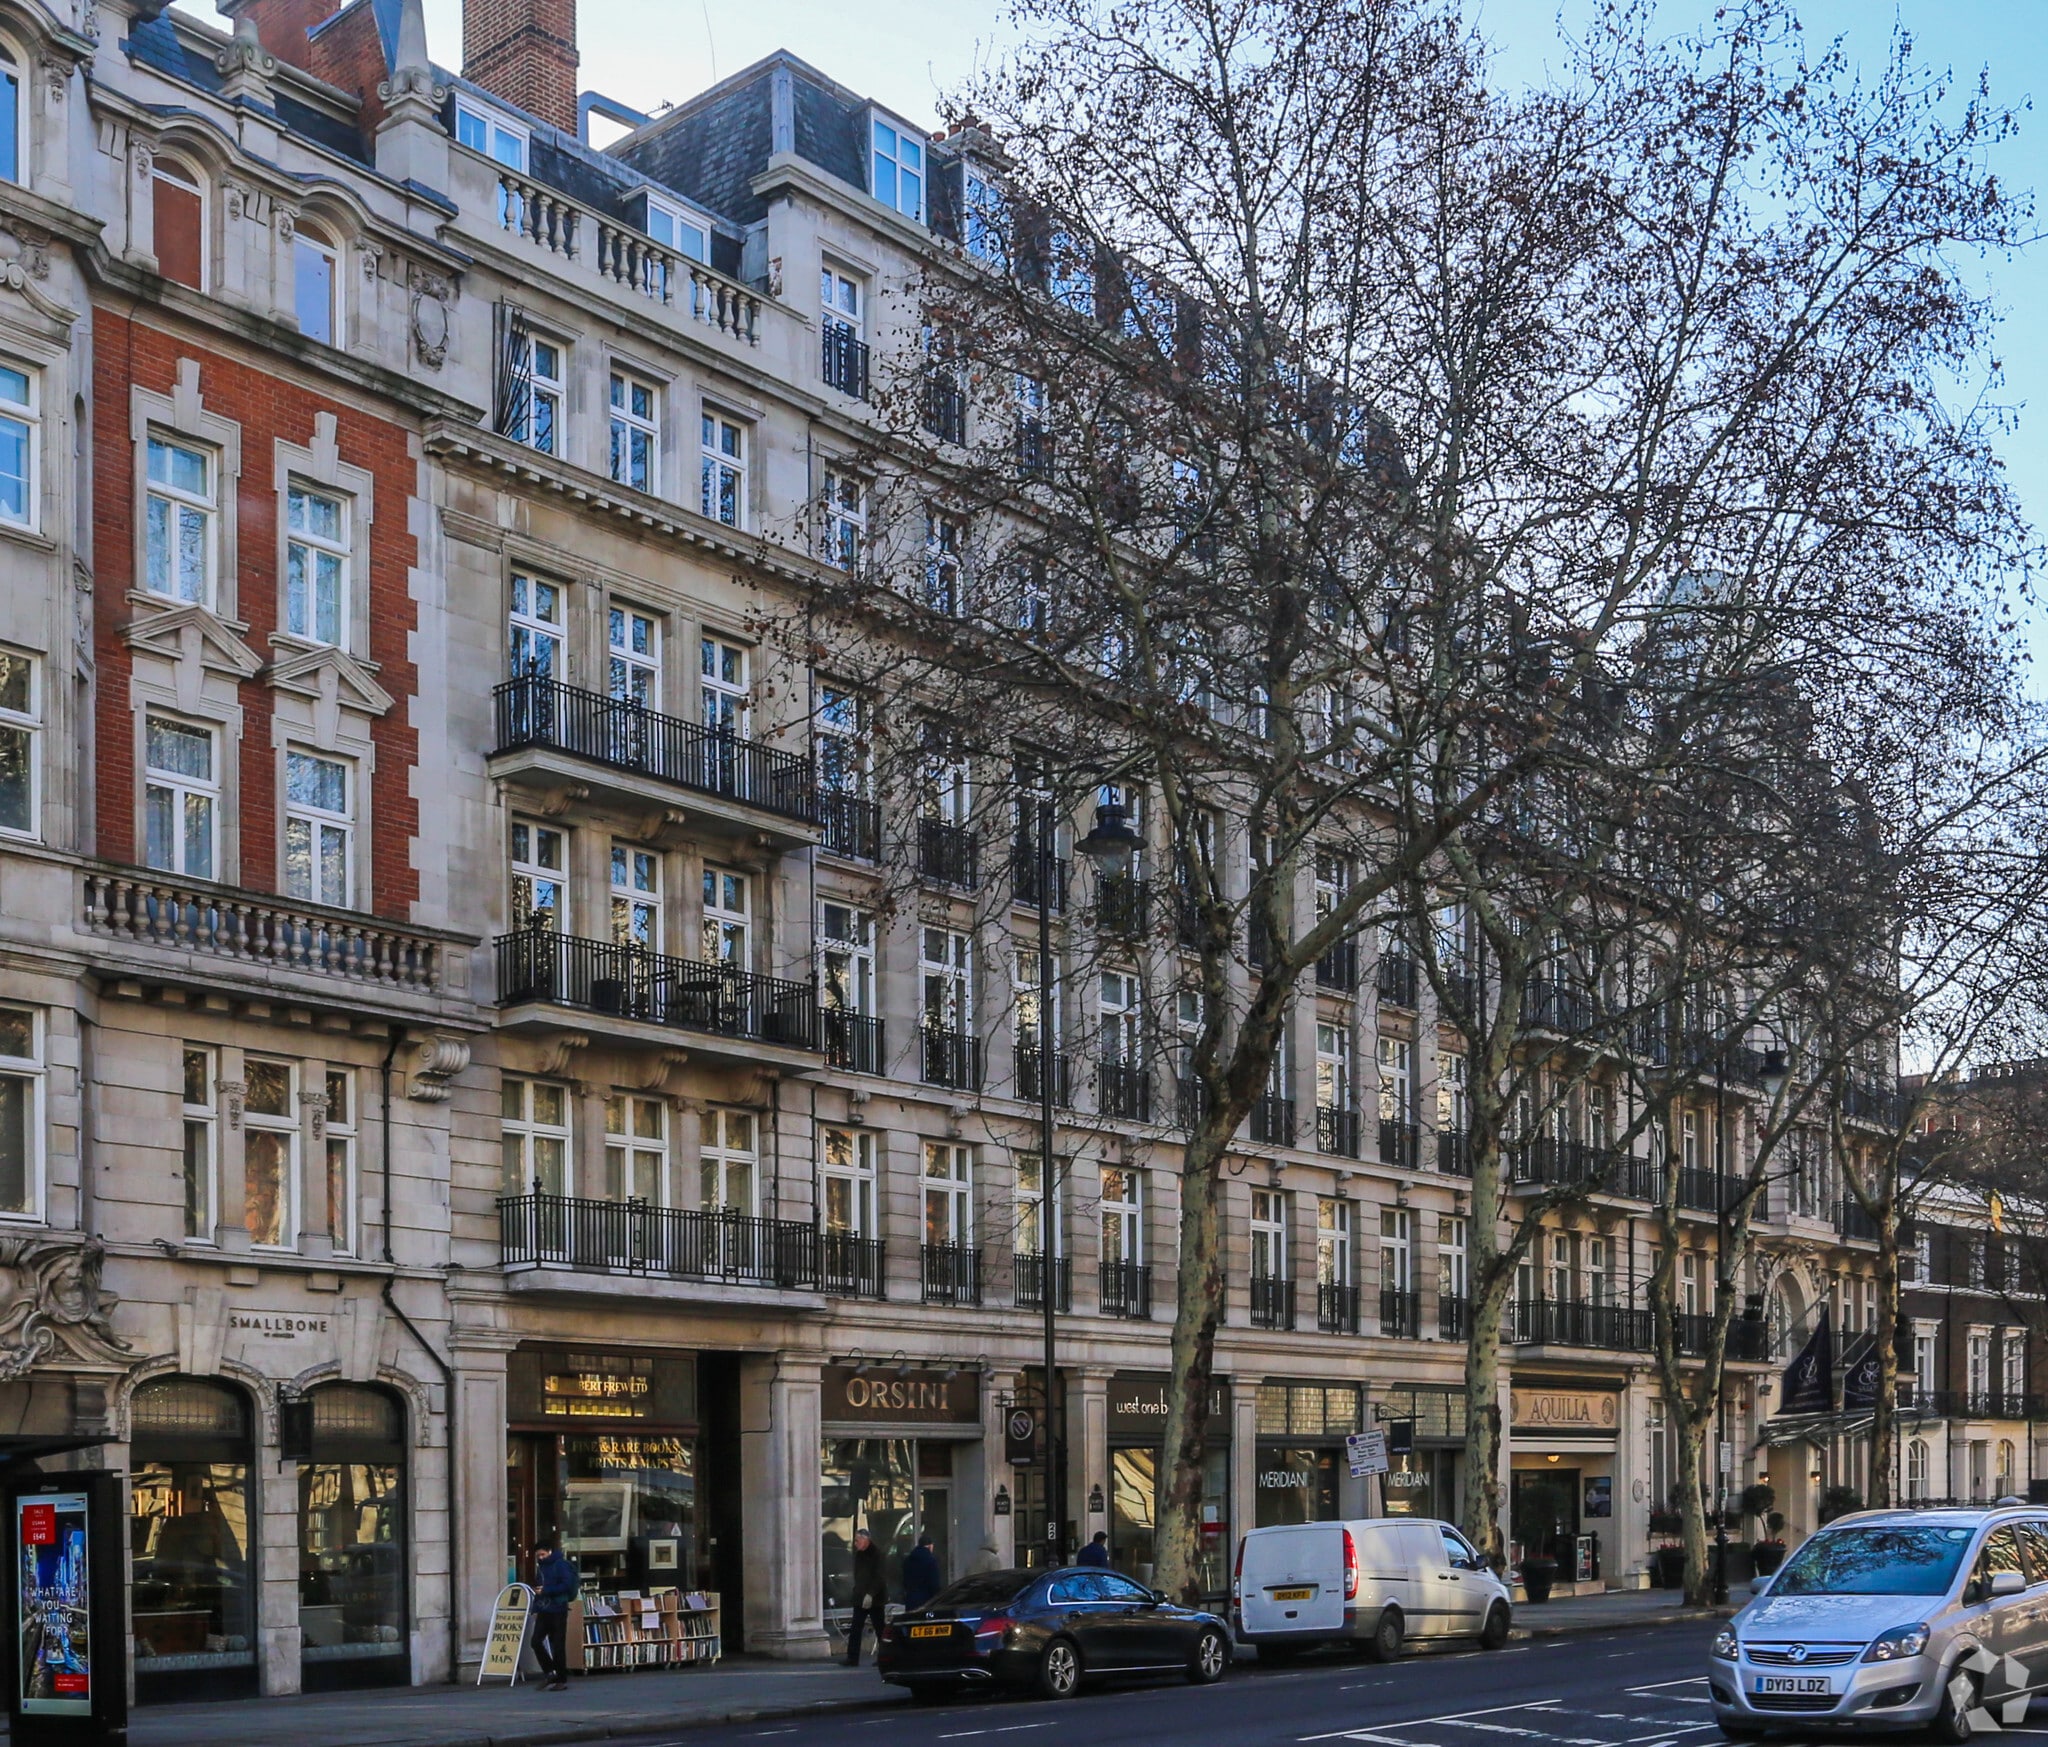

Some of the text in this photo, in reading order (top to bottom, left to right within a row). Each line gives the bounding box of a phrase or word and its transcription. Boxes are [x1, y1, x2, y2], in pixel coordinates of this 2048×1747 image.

[230, 1316, 327, 1332] SMALLBONE
[604, 1382, 629, 1393] FREW
[630, 1383, 648, 1393] LTD
[846, 1378, 949, 1409] ORSINI
[1116, 1396, 1159, 1414] west one
[1530, 1397, 1590, 1425] AQUILLA
[611, 1442, 640, 1453] RARE
[588, 1457, 627, 1468] PRINTS
[640, 1458, 669, 1469] MAPS
[1259, 1471, 1308, 1488] MERIDIANI
[31, 1586, 76, 1597] WHAT ARE
[41, 1600, 59, 1610] YOU
[34, 1613, 73, 1623] WAITING
[494, 1622, 523, 1631] BOOKS
[492, 1633, 521, 1642] PRINTS
[500, 1644, 507, 1653] &
[491, 1655, 513, 1663] MAPS
[1766, 1679, 1824, 1692] DY13 LDZ
